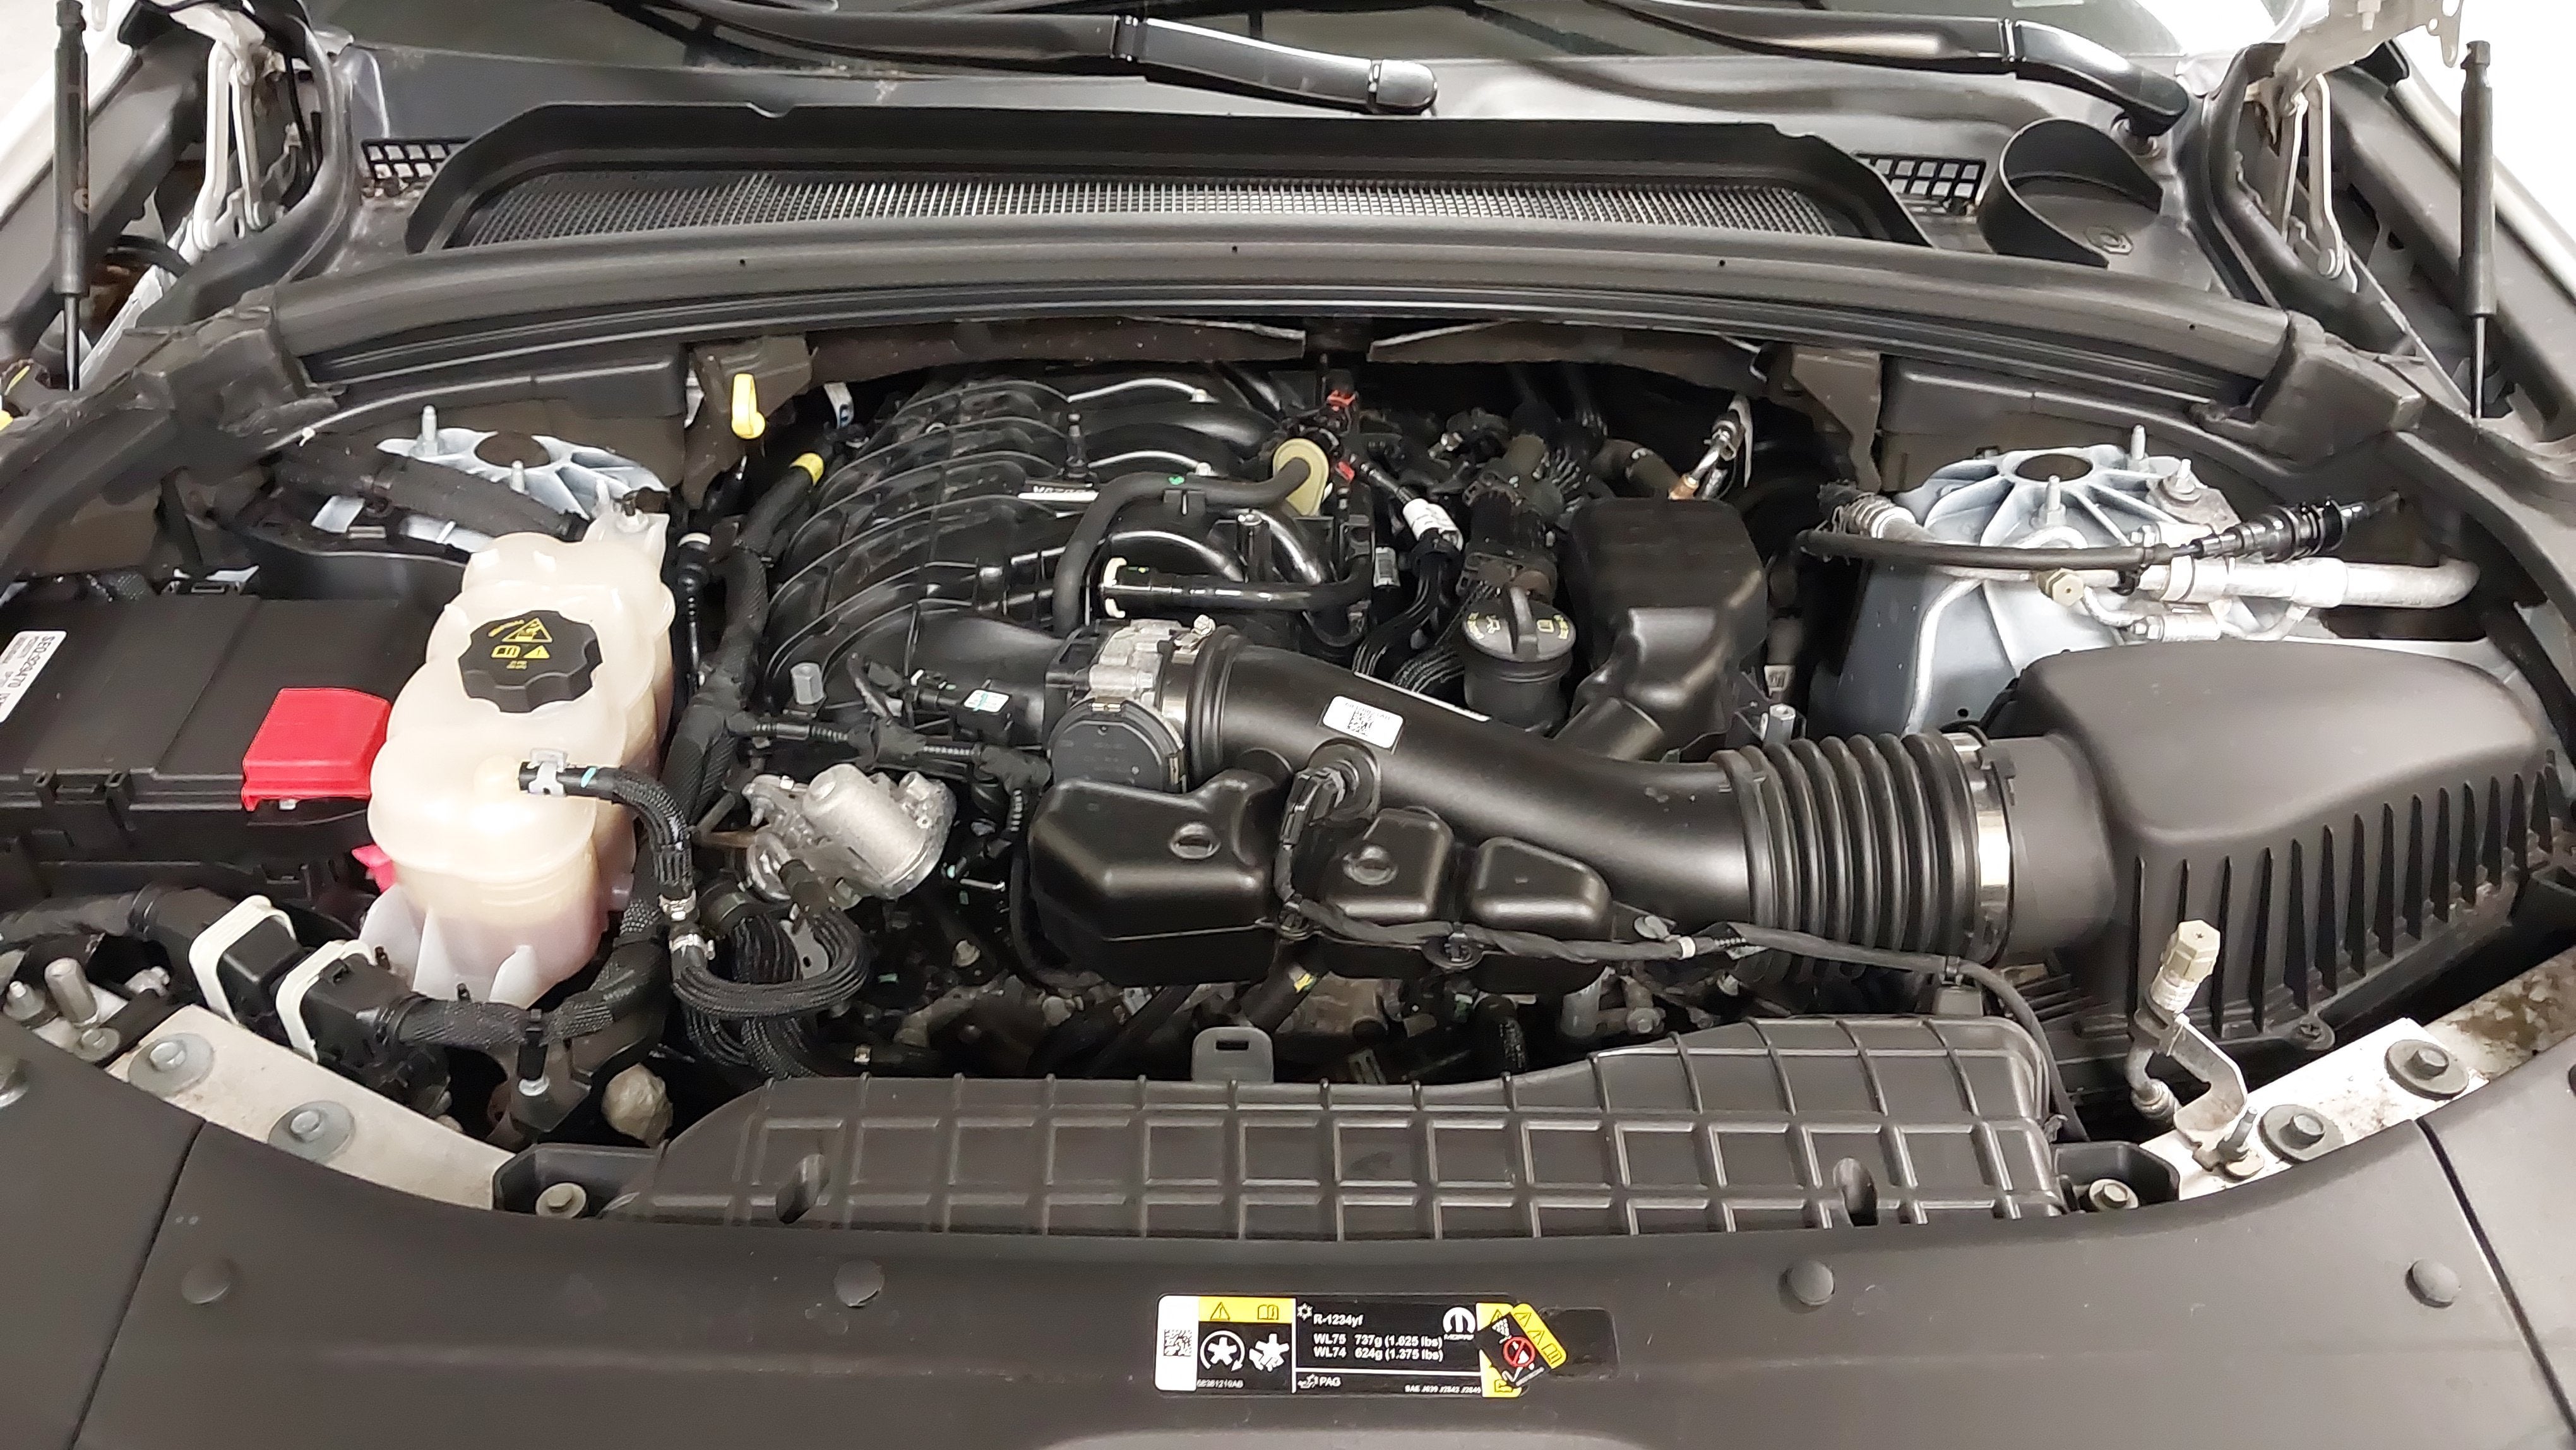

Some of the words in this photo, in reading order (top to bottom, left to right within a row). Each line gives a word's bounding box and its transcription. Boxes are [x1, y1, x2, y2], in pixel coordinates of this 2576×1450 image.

[1313, 1313, 1364, 1328] R-1234yf
[1313, 1333, 1347, 1345] WL75
[1354, 1333, 1383, 1348] 737g
[1384, 1334, 1419, 1348] (1.625
[1421, 1335, 1443, 1350] lbs)
[1313, 1346, 1347, 1358] WL74
[1354, 1346, 1383, 1361] 624g
[1385, 1348, 1420, 1362] (1.375
[1421, 1348, 1444, 1363] lbs)
[1319, 1376, 1342, 1387] PAG
